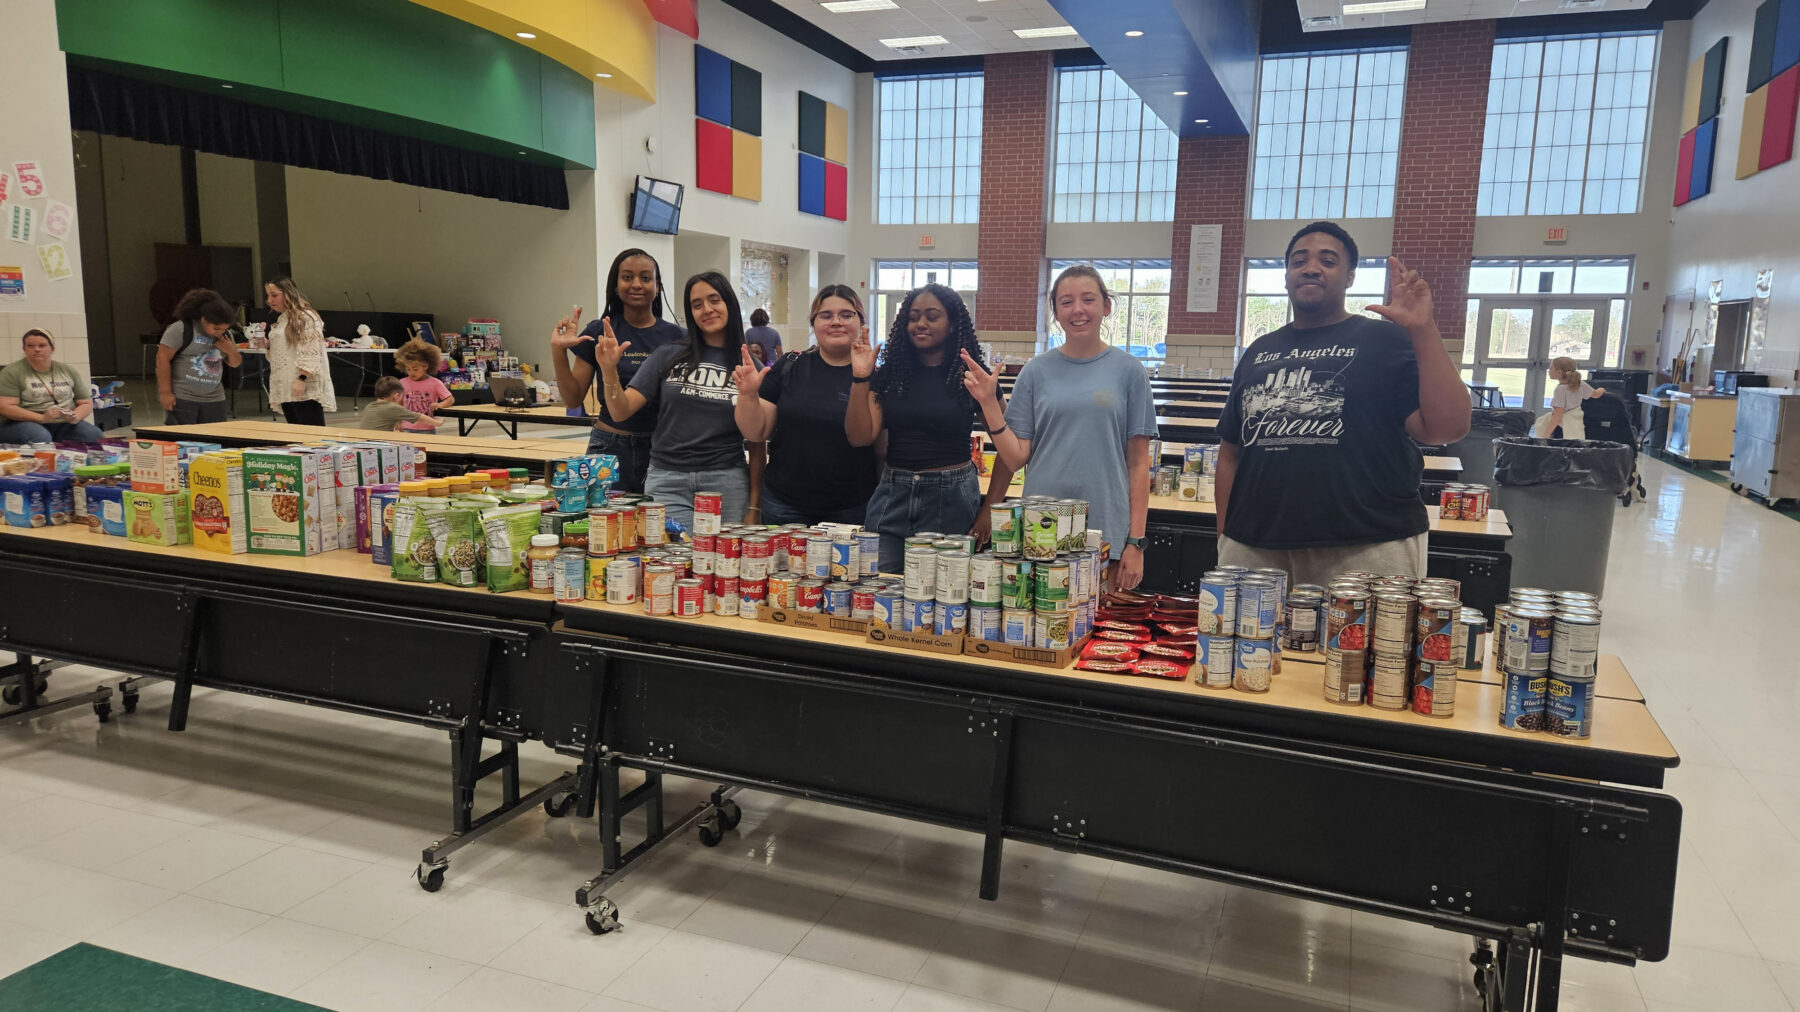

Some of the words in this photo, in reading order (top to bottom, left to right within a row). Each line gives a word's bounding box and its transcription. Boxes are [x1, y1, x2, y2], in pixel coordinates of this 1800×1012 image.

[16, 163, 43, 197] 5
[47, 205, 69, 235] 6
[921, 236, 932, 246] EXIT
[1548, 228, 1564, 240] EXIT
[39, 245, 69, 278] 12
[1254, 351, 1281, 364] Los
[1284, 344, 1356, 360] Angeles
[1242, 406, 1345, 447] Forever
[246, 461, 275, 470] Holiday
[193, 471, 221, 488] Cheerios
[888, 634, 910, 642] Whole
[911, 638, 933, 646] Kernel
